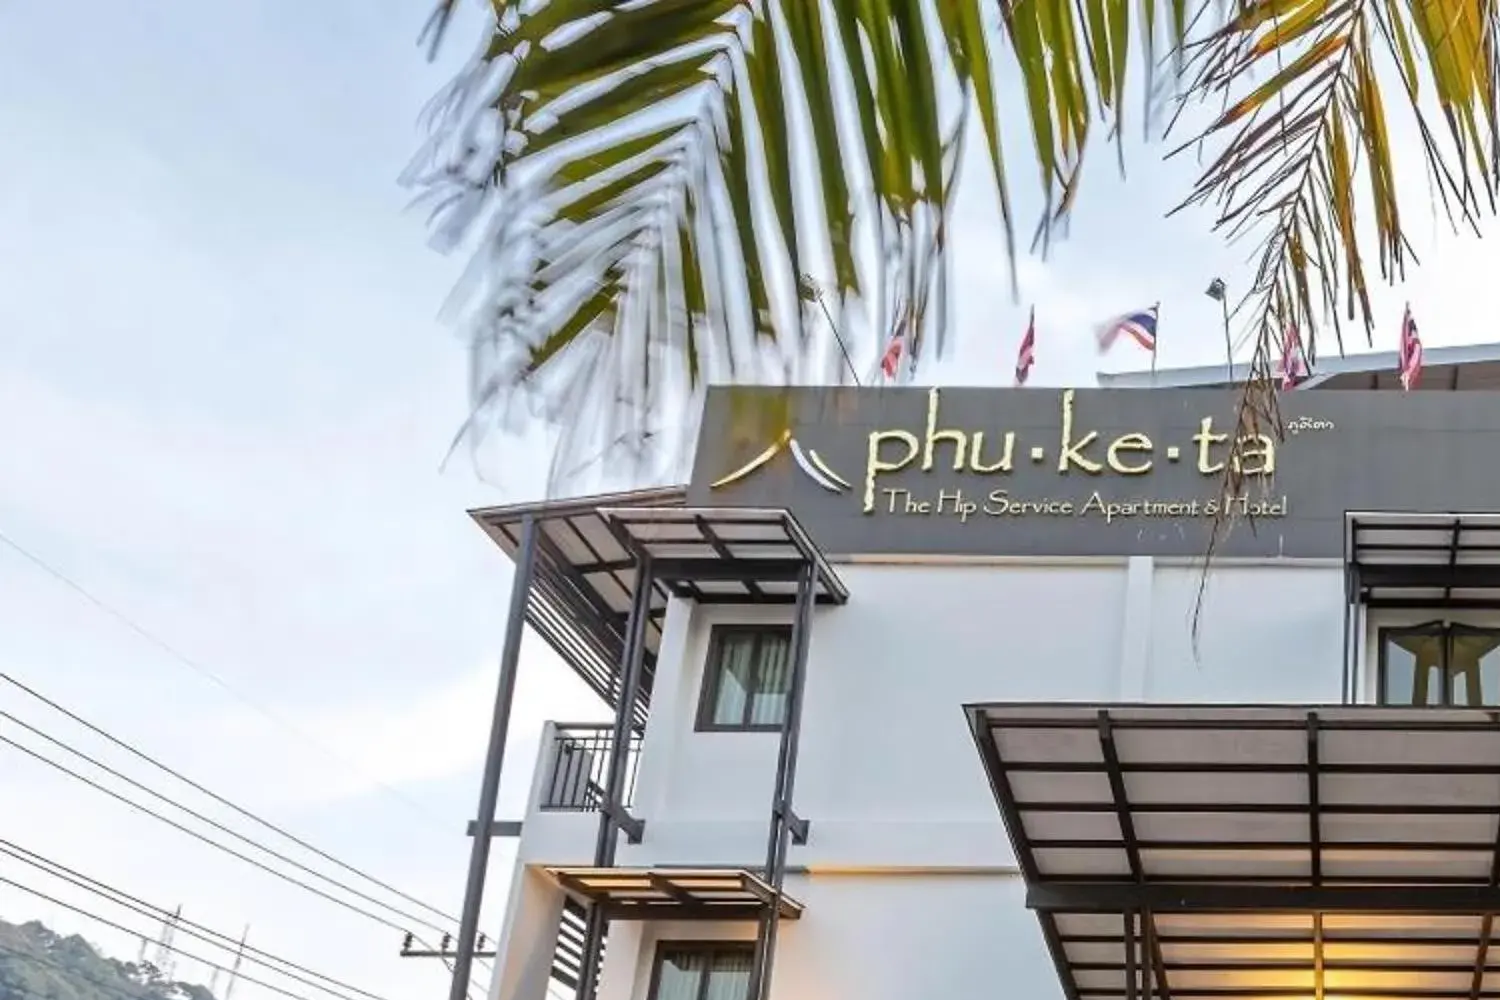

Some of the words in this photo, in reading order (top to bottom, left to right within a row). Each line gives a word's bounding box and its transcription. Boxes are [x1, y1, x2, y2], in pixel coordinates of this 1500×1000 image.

[882, 487, 931, 514] The
[937, 488, 977, 523] Hip
[983, 489, 1072, 516] Service
[1079, 491, 1200, 524] Apartment
[1224, 493, 1288, 517] Hotel
